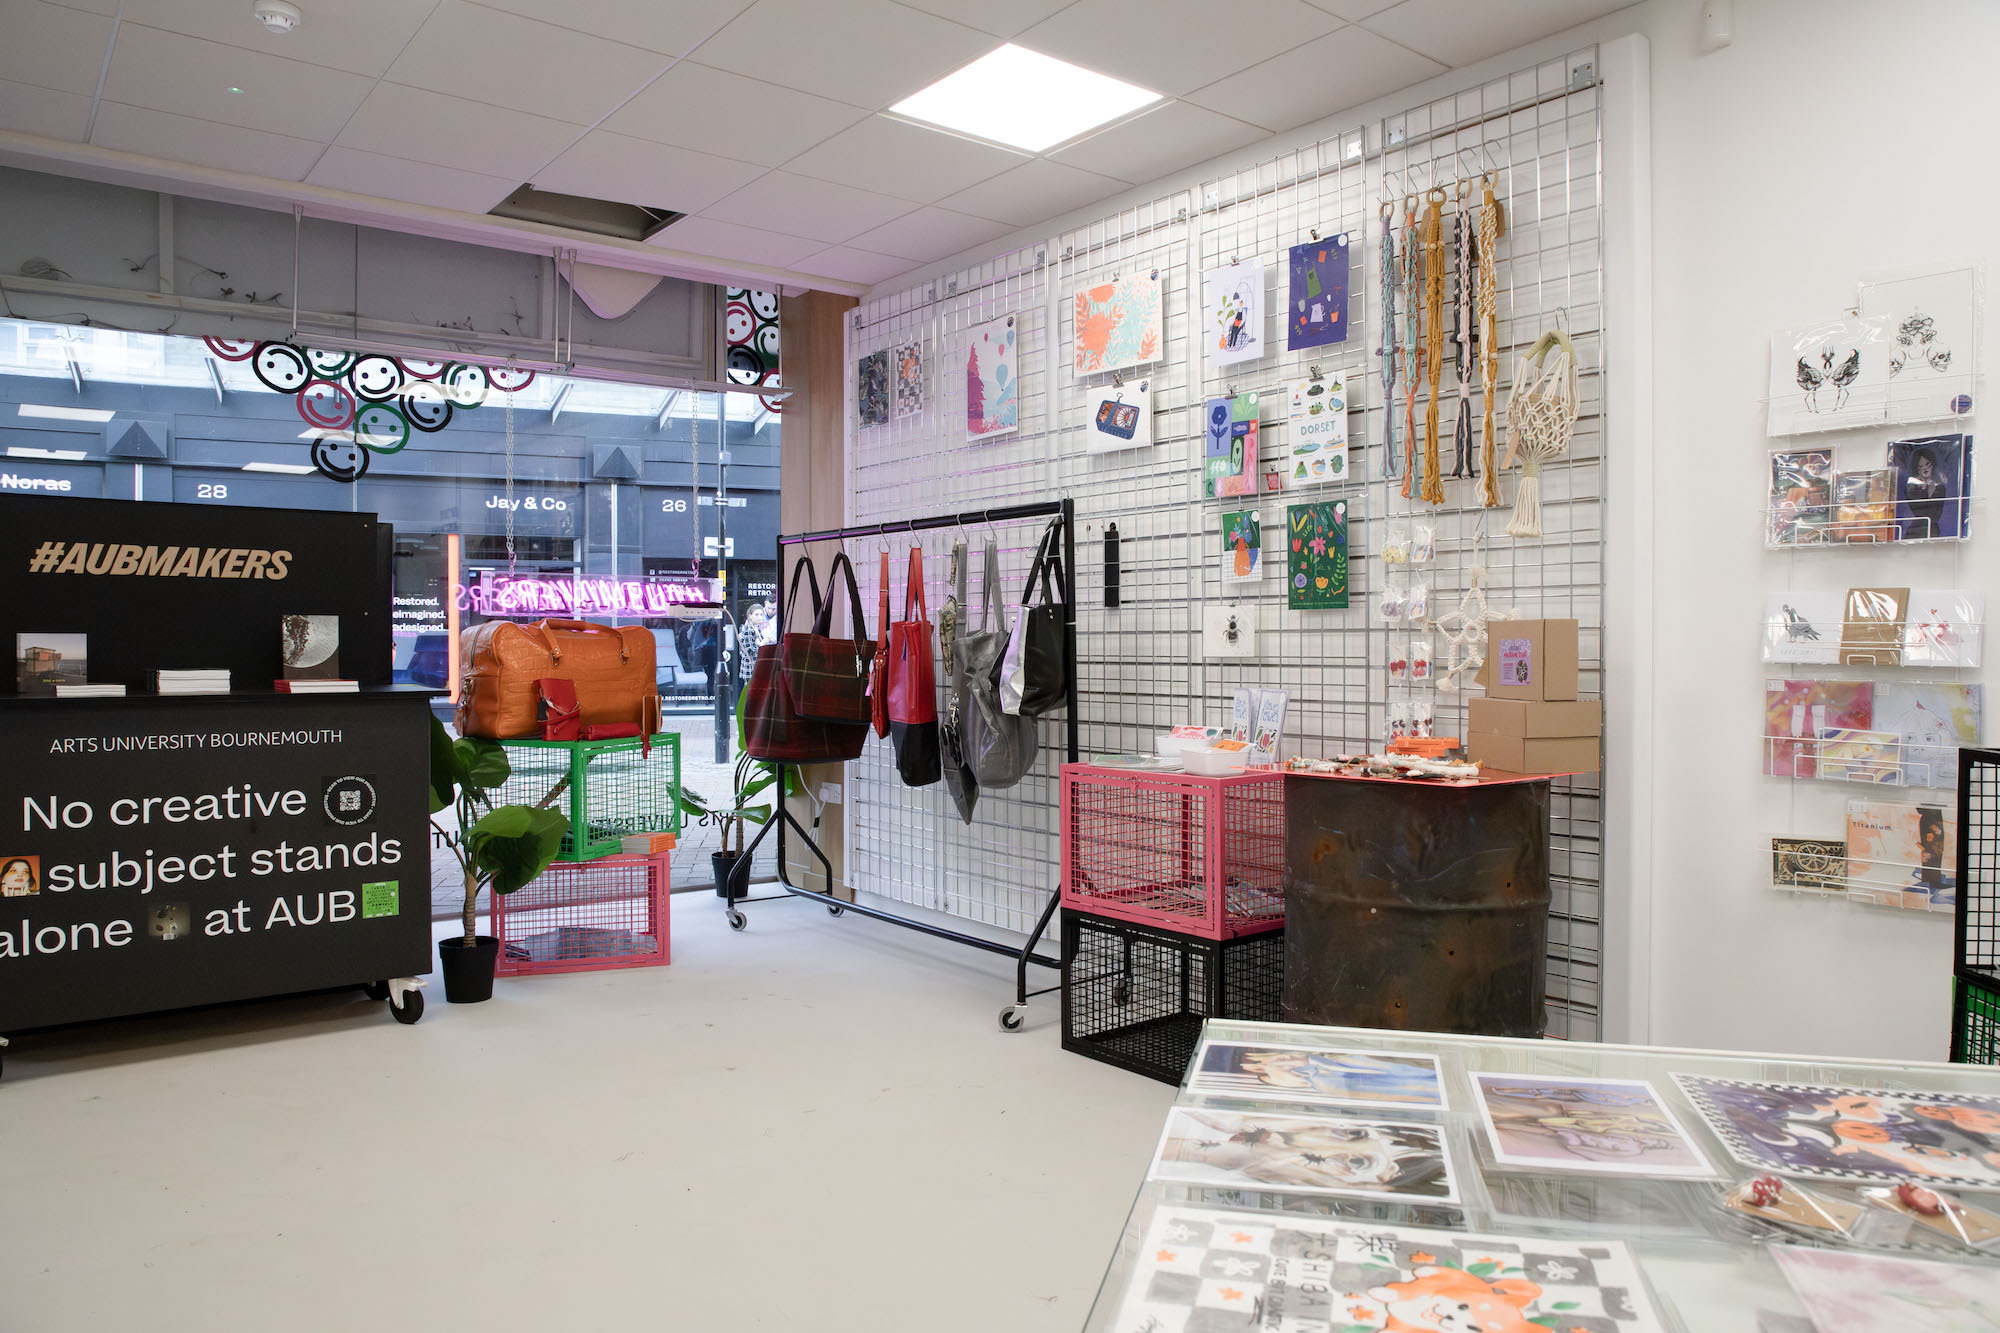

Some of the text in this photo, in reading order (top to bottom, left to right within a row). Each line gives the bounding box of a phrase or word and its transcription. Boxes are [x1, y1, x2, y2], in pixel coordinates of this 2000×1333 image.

[1301, 420, 1336, 436] DORSET
[1, 474, 72, 491] Noras
[197, 484, 228, 499] 28
[486, 495, 567, 511] Jay & Co
[661, 499, 687, 513] 26
[29, 541, 293, 580] #AUBMAKERS
[393, 596, 440, 606] Restored.
[50, 729, 342, 753] ARTS UNIVERSITY BOURNEMOUTH
[24, 783, 307, 831] No creative
[48, 832, 402, 894] subject stands
[0, 918, 133, 958] alone
[204, 900, 250, 936] at
[265, 890, 356, 930] AUB
[1300, 1250, 1332, 1307] SHIBA
